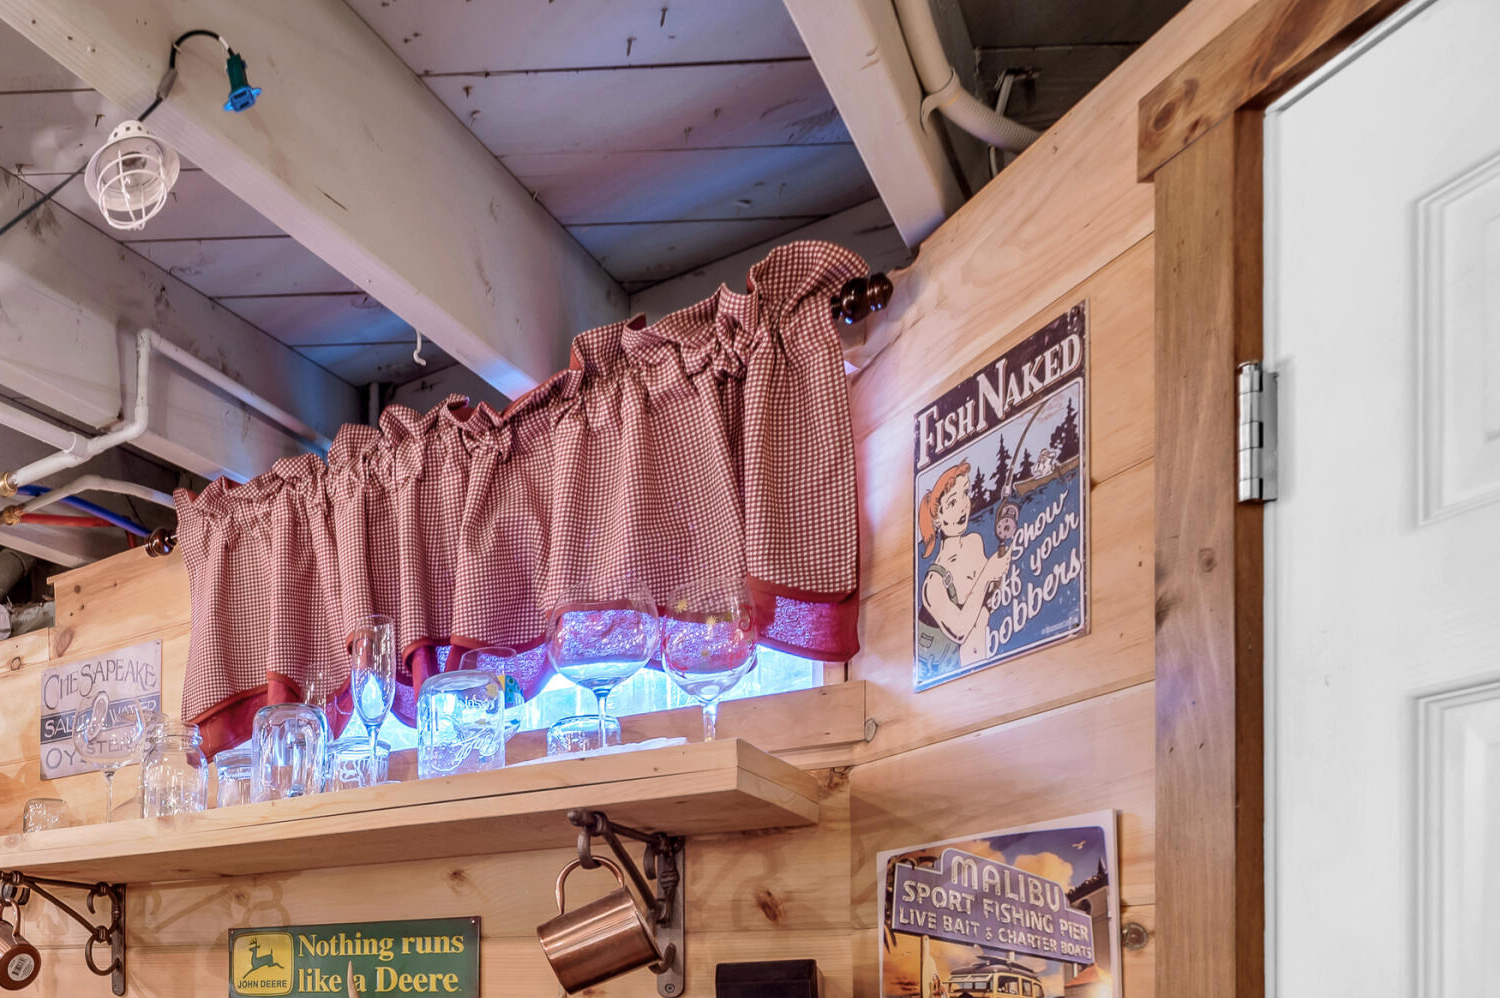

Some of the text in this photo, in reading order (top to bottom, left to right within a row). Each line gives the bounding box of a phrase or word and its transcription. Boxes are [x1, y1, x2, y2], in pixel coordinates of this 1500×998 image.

[917, 334, 1083, 470] FISH NAKED
[1011, 489, 1069, 560] Show
[988, 512, 1079, 611] off your
[985, 548, 1081, 660] bobbers
[902, 879, 1089, 942] SPORT FISHING PIER
[951, 855, 1061, 913] MALIBU
[298, 932, 465, 962] Nothing runs
[899, 907, 937, 930] LIVE
[943, 914, 980, 937] BAIT
[998, 927, 1058, 951] CHARTER
[1060, 940, 1092, 960] BOATS
[237, 979, 288, 989] JOHN DEERE
[298, 968, 342, 993] like
[353, 974, 367, 993] a
